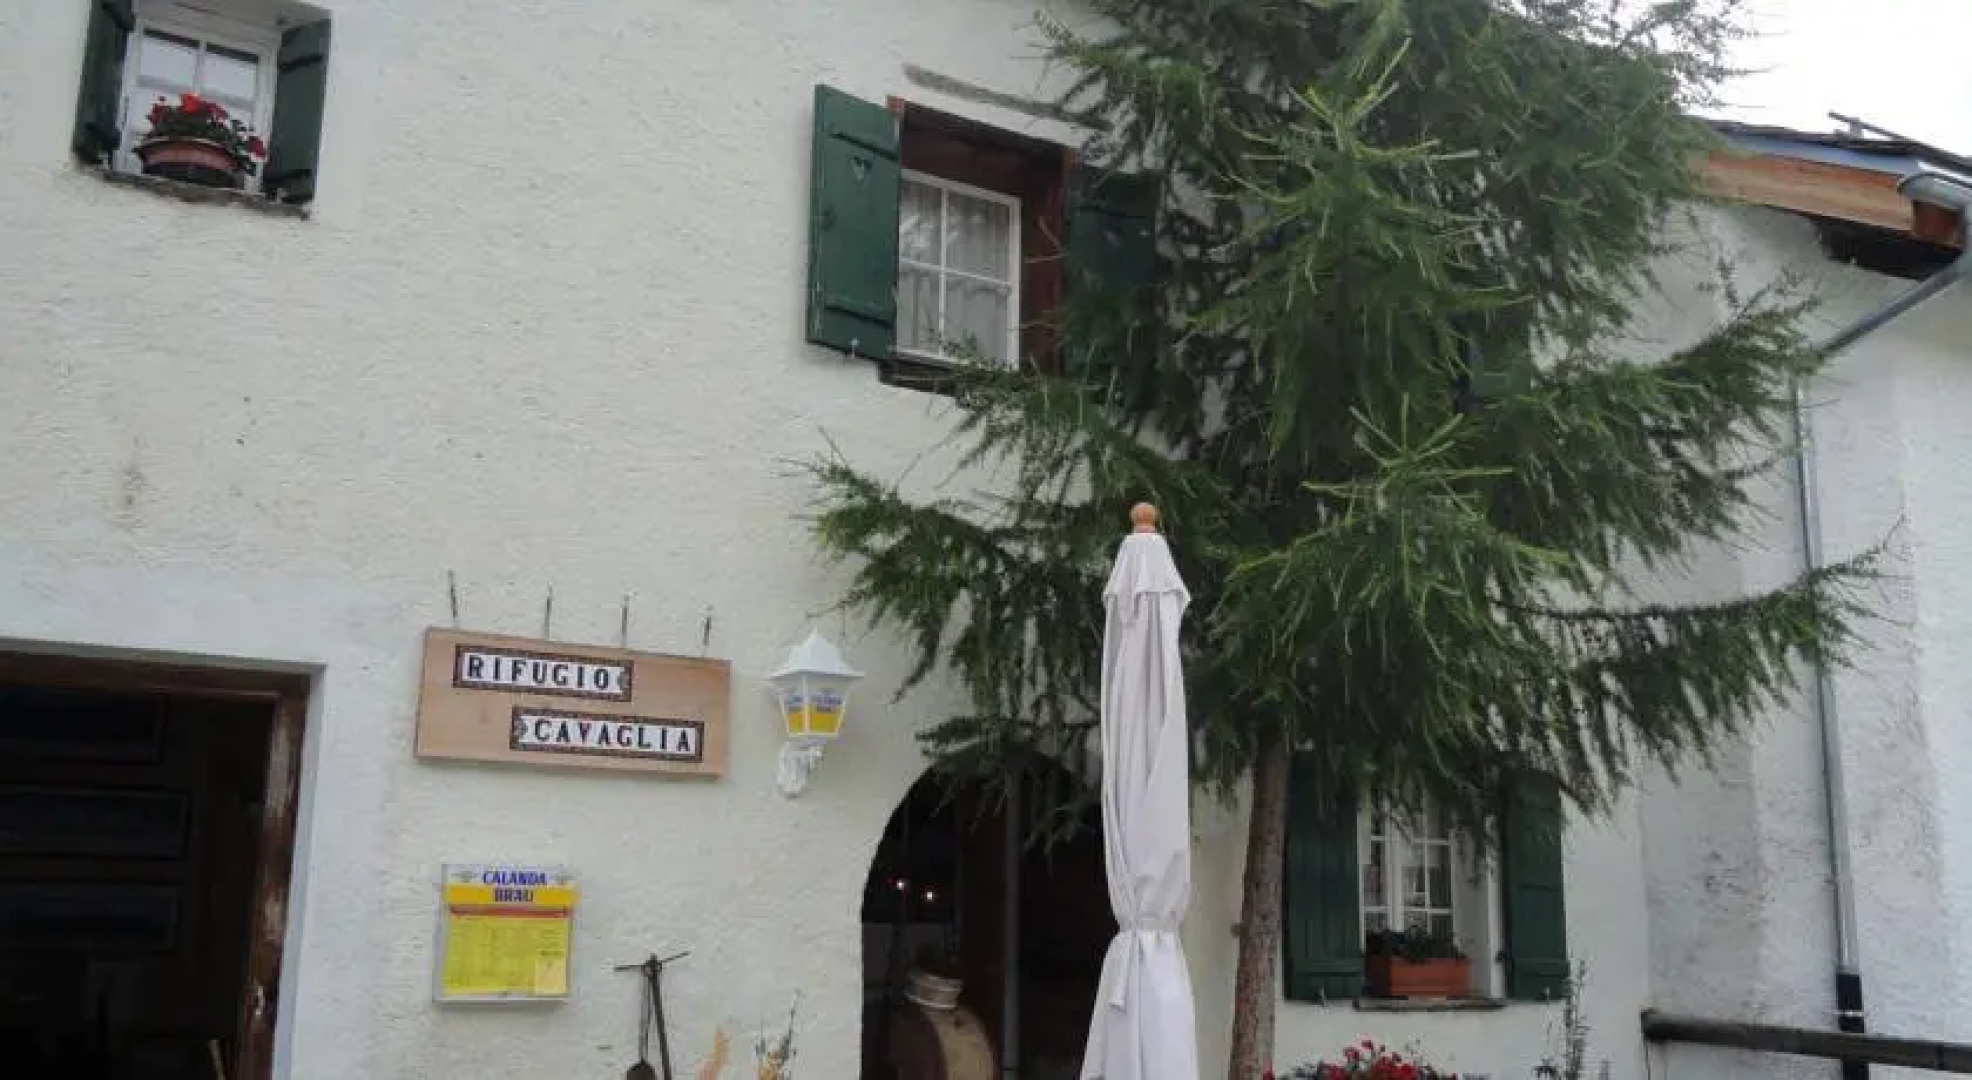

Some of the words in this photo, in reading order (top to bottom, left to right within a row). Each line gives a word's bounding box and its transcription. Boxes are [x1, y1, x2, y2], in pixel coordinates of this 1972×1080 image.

[467, 654, 611, 691] RIFUGIO
[533, 719, 692, 752] CAVAGLIA
[483, 870, 548, 886] CALANDA
